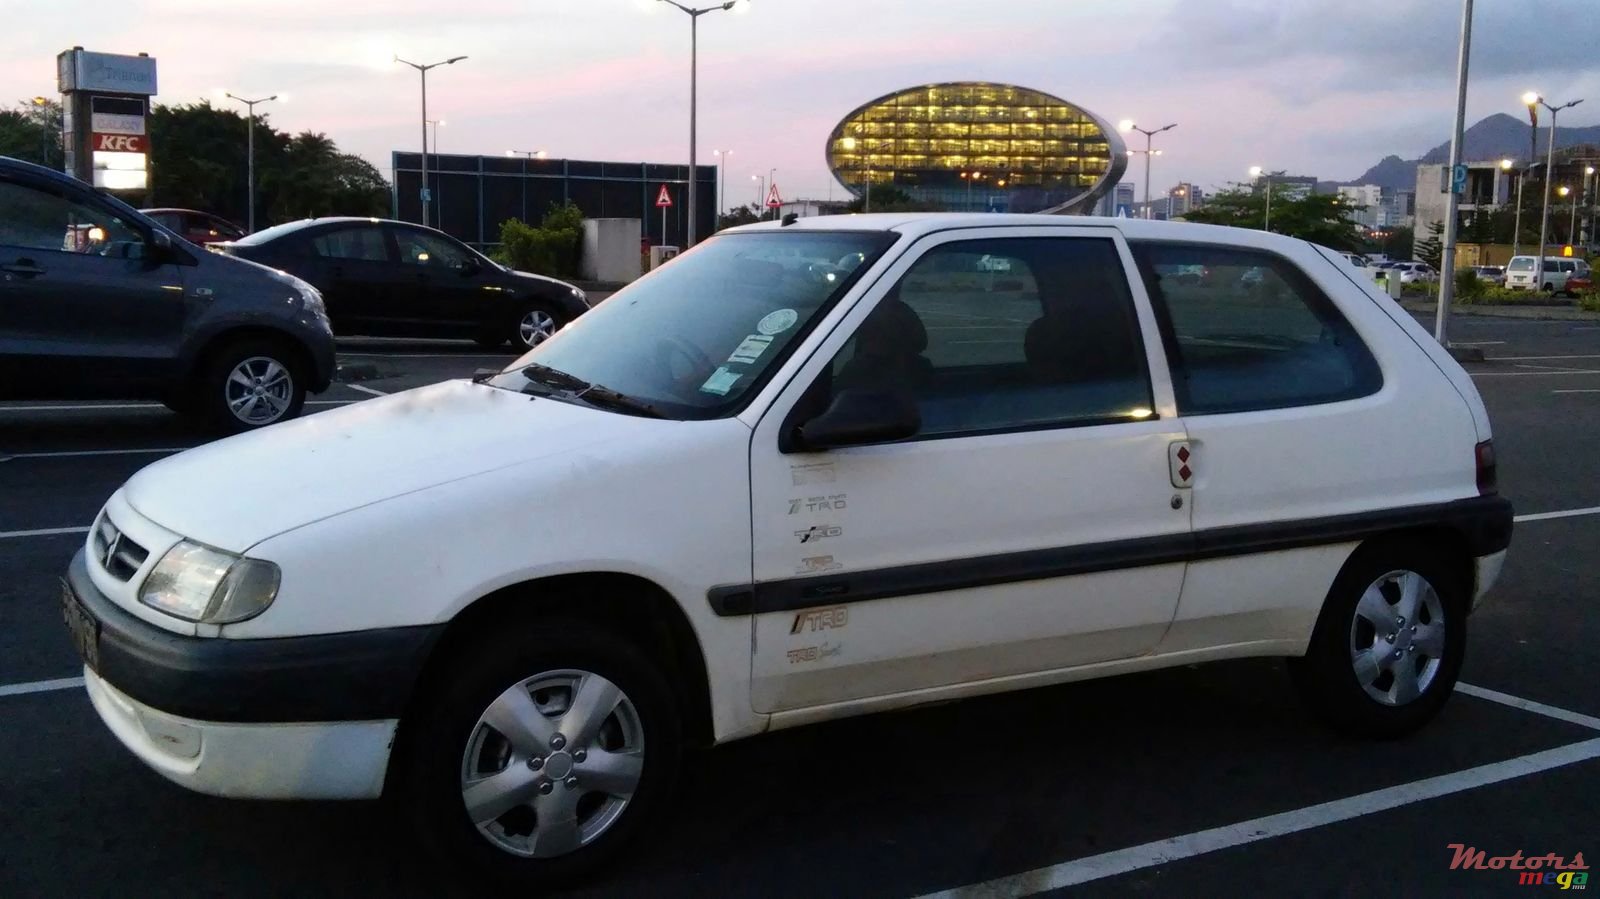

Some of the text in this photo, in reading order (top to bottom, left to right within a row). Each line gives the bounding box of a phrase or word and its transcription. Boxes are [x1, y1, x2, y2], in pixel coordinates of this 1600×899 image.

[100, 135, 138, 151] KFC
[805, 500, 846, 512] TRD
[804, 606, 849, 632] TRD
